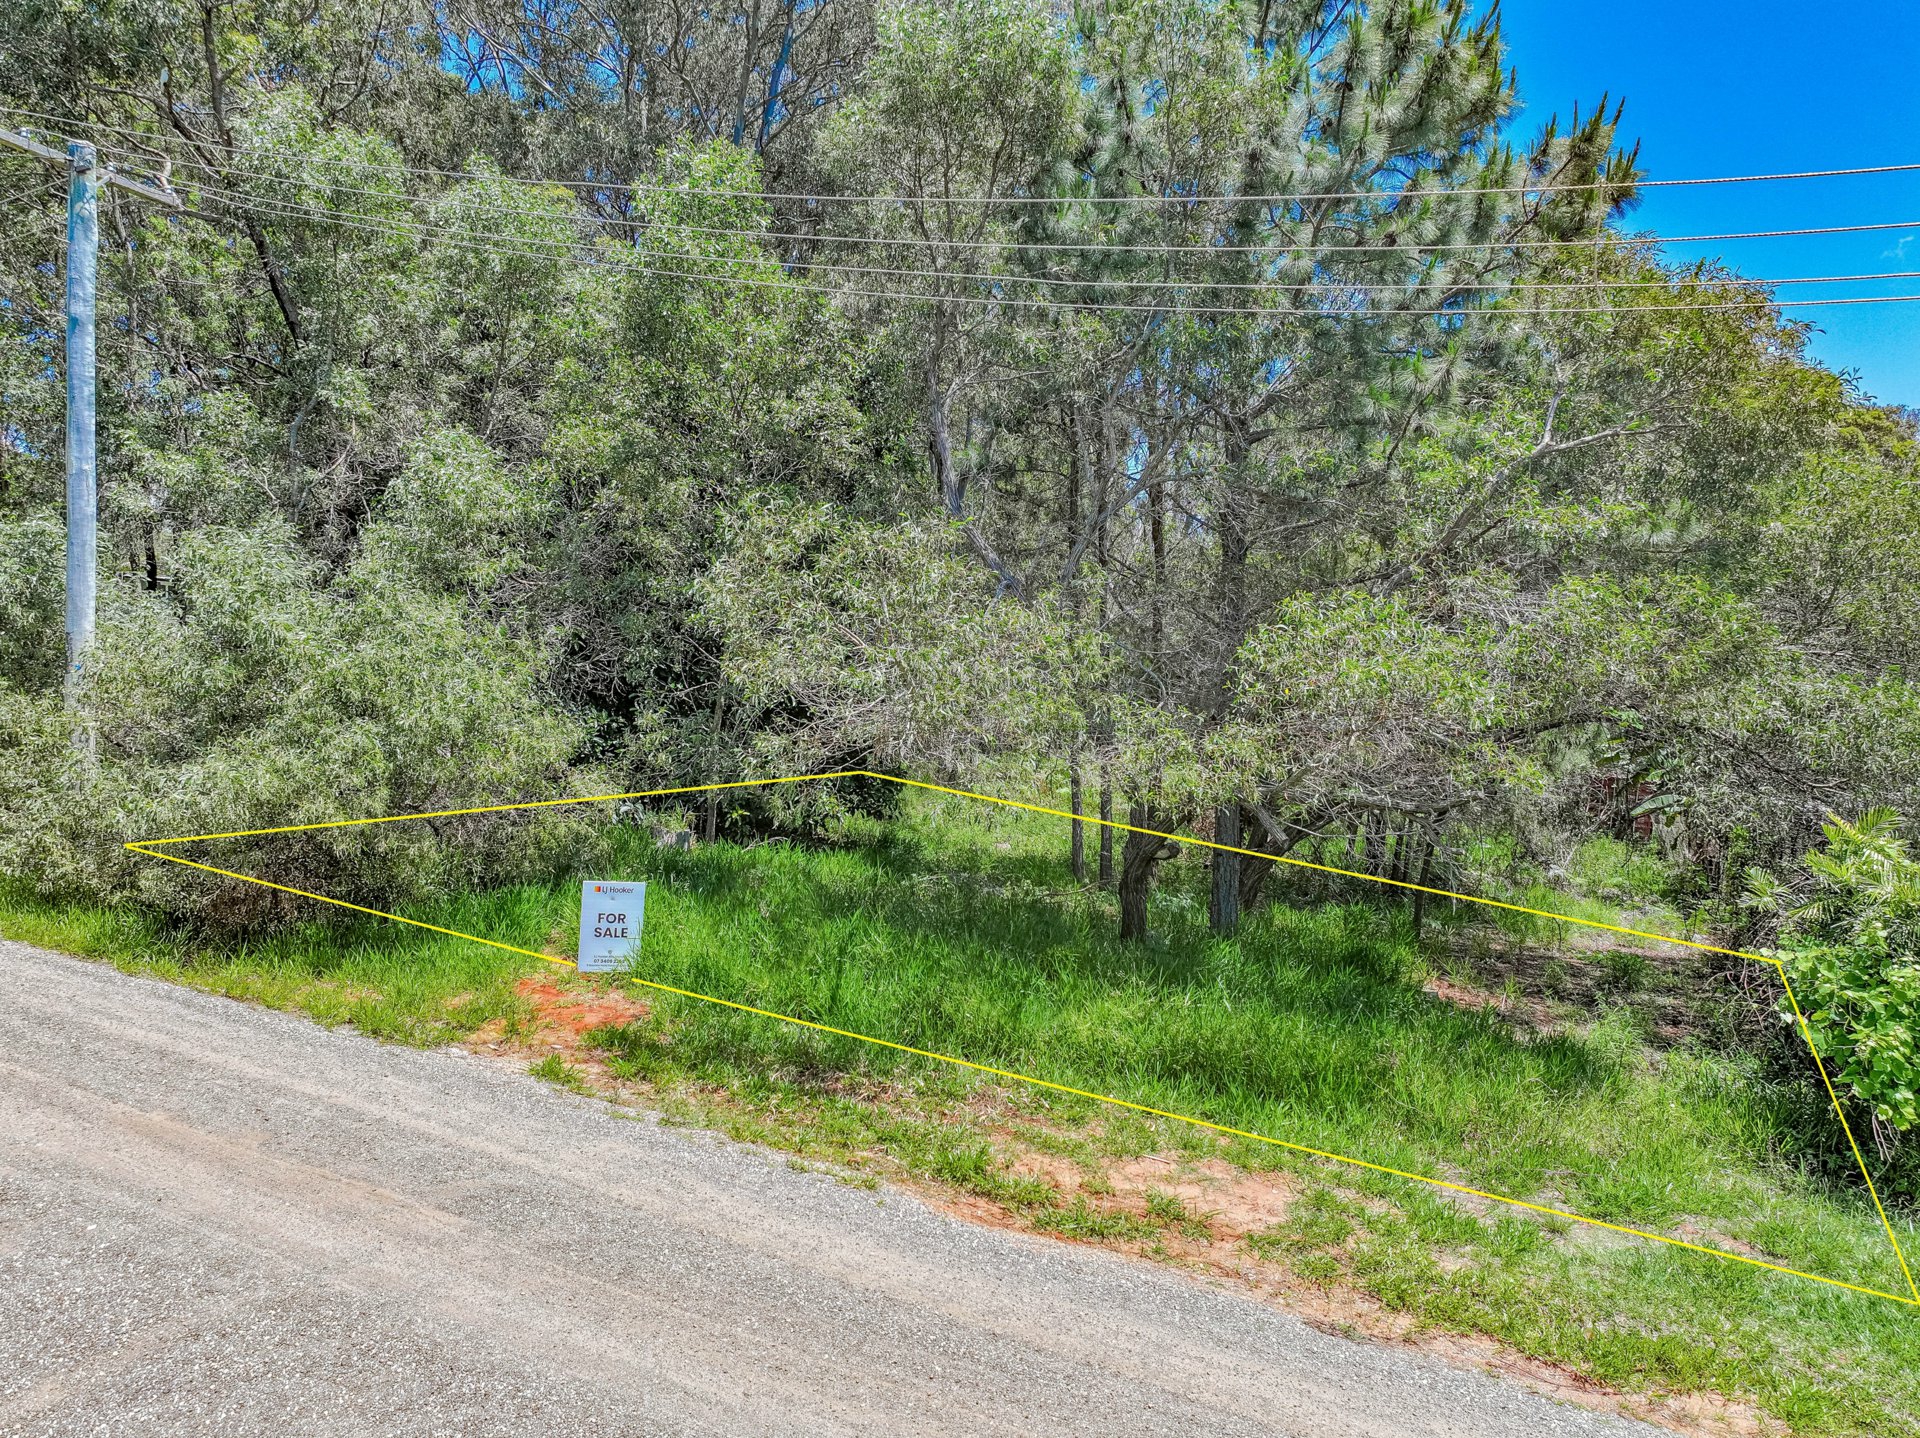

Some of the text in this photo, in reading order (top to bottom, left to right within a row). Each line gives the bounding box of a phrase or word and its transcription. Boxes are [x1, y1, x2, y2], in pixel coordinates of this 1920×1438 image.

[602, 886, 608, 894] LJ
[598, 913, 626, 924] FOR
[594, 927, 628, 938] SALE
